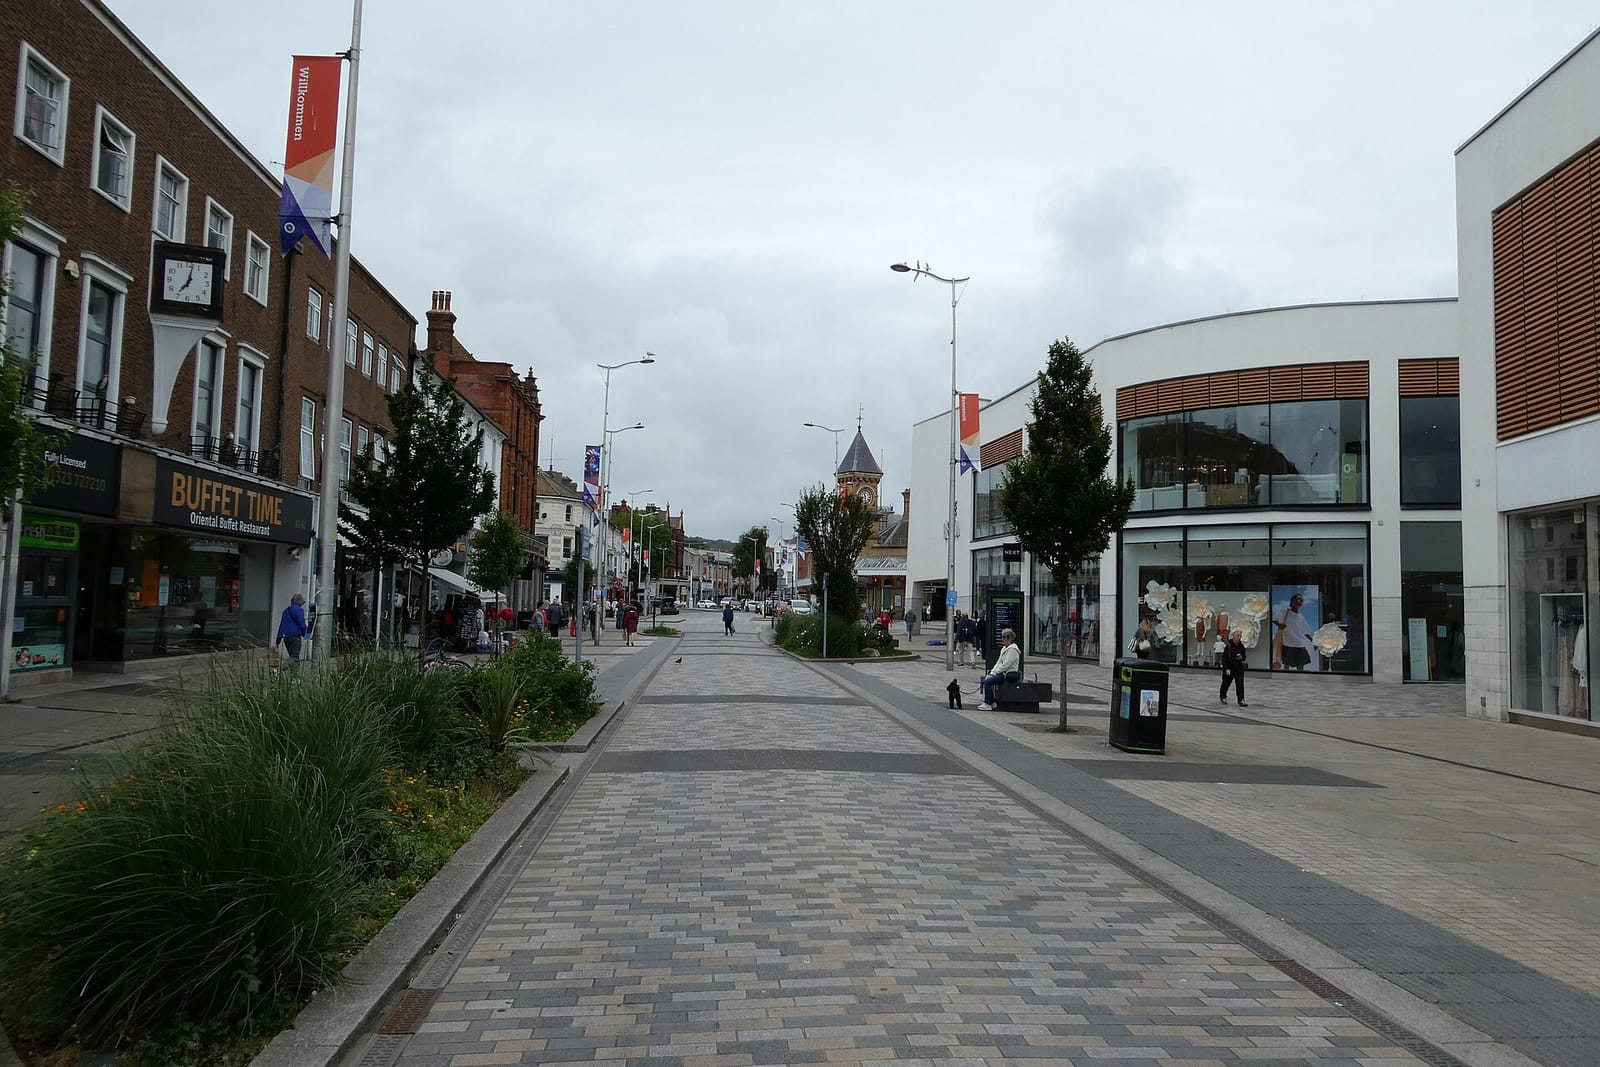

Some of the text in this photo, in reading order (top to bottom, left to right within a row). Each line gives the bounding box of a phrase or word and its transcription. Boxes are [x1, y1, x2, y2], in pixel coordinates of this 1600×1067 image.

[294, 66, 309, 141] Willkommen
[44, 450, 86, 469] Fully Licensed
[73, 474, 106, 492] 727210
[171, 471, 284, 526] BUFFET TIME
[190, 511, 270, 536] Oriental Buffet Restaurant
